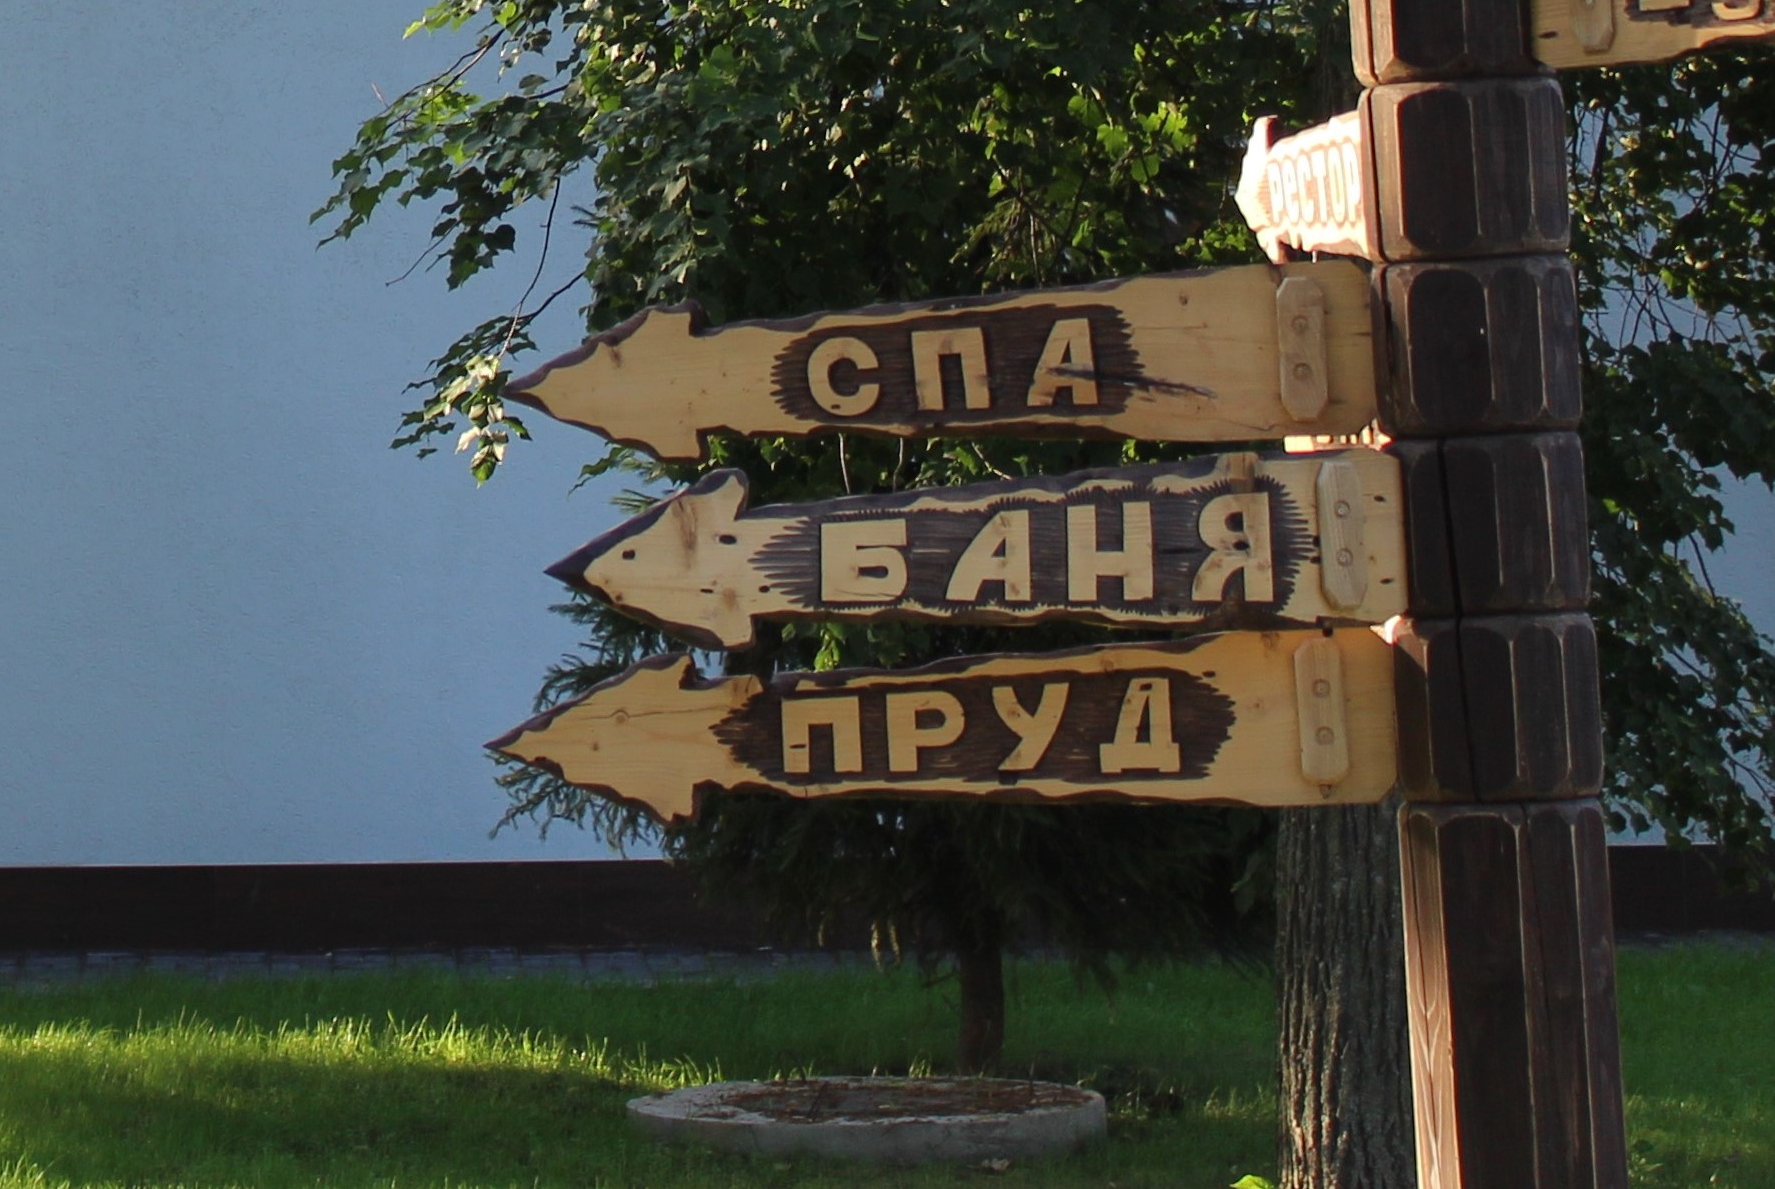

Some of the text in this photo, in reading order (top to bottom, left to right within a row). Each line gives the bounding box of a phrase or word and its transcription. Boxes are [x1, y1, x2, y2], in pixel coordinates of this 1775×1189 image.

[807, 318, 1098, 416] СПА
[819, 491, 1275, 603] БАНЯ
[780, 677, 1181, 774] ПРУД
